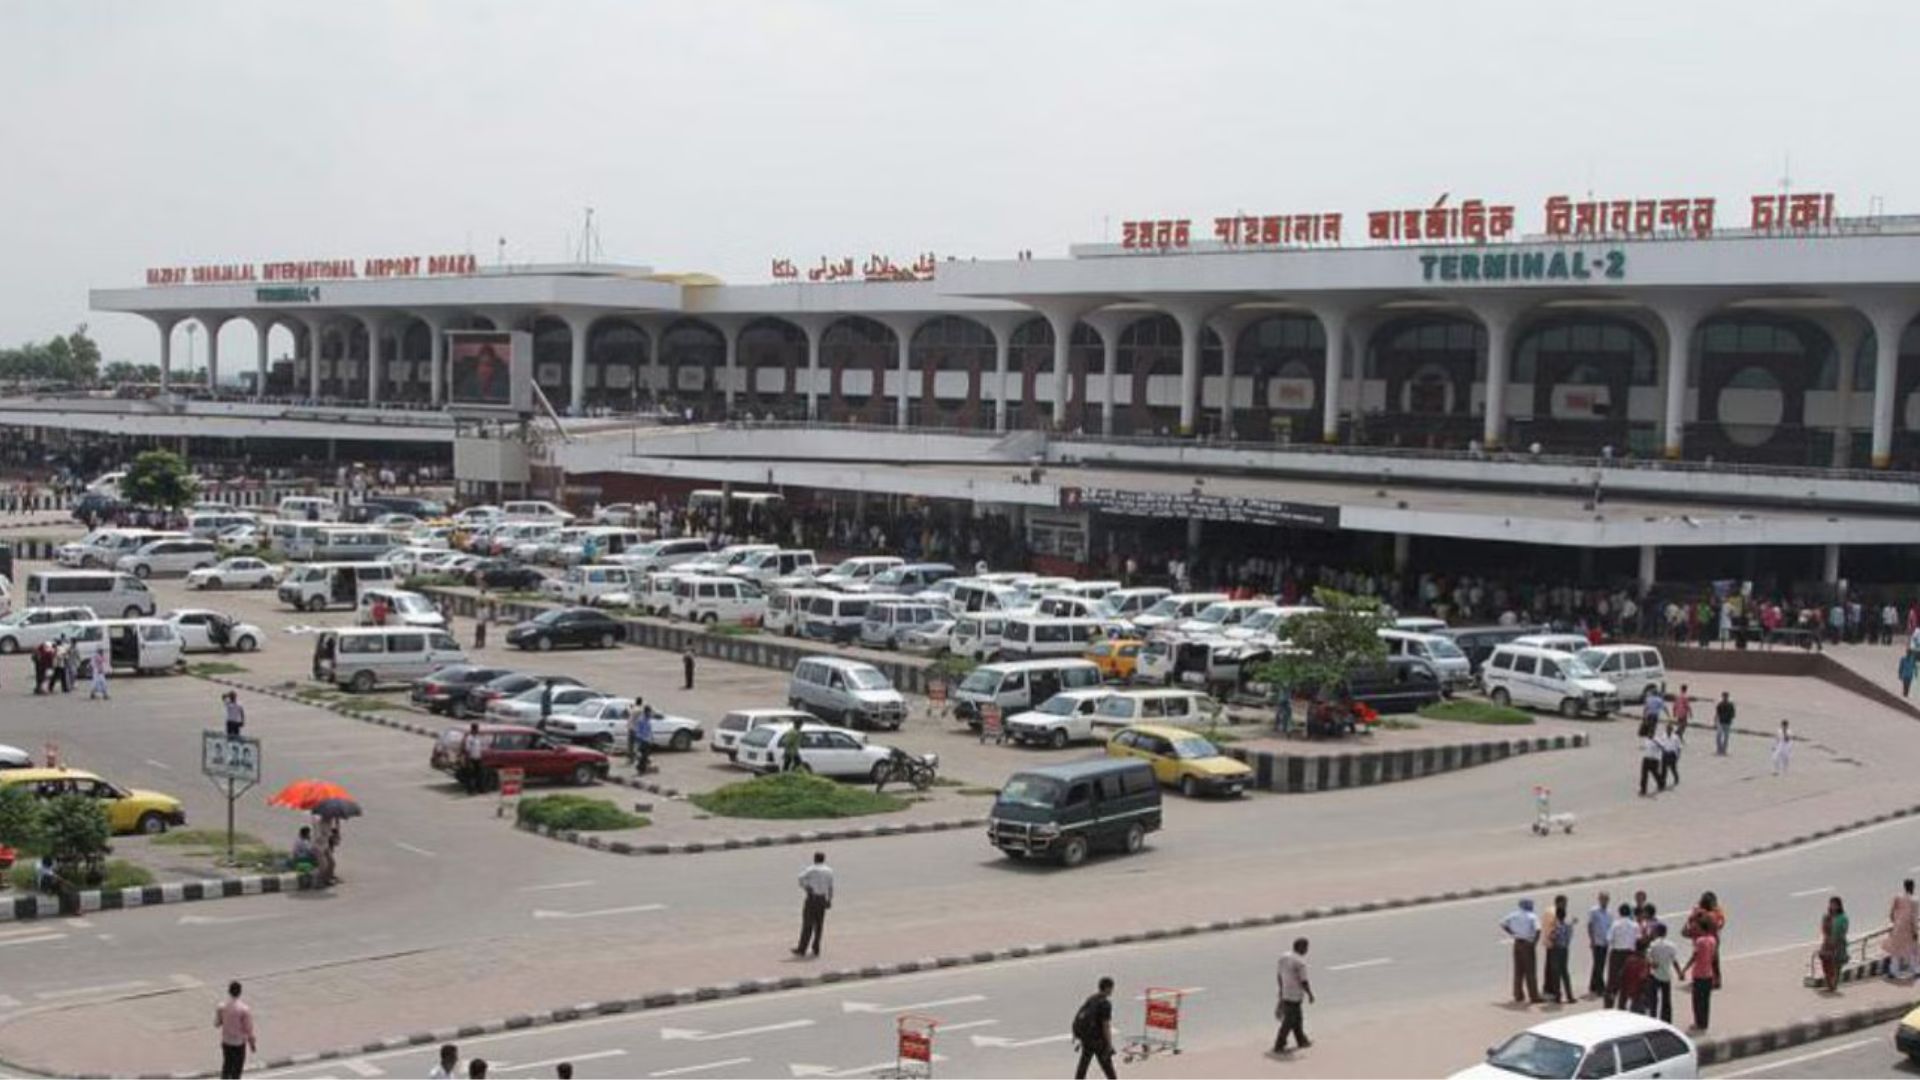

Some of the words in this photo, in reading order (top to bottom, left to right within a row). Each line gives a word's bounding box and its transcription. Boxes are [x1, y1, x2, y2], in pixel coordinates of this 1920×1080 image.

[1545, 196, 1716, 239] বিমানবন্দর
[1751, 193, 1834, 230] ঢাকা
[263, 261, 357, 281] INTERNATIONAL
[365, 257, 421, 276] AIRPORT
[428, 255, 476, 274] DHAKA
[1420, 252, 1625, 281] TERMINAL-2
